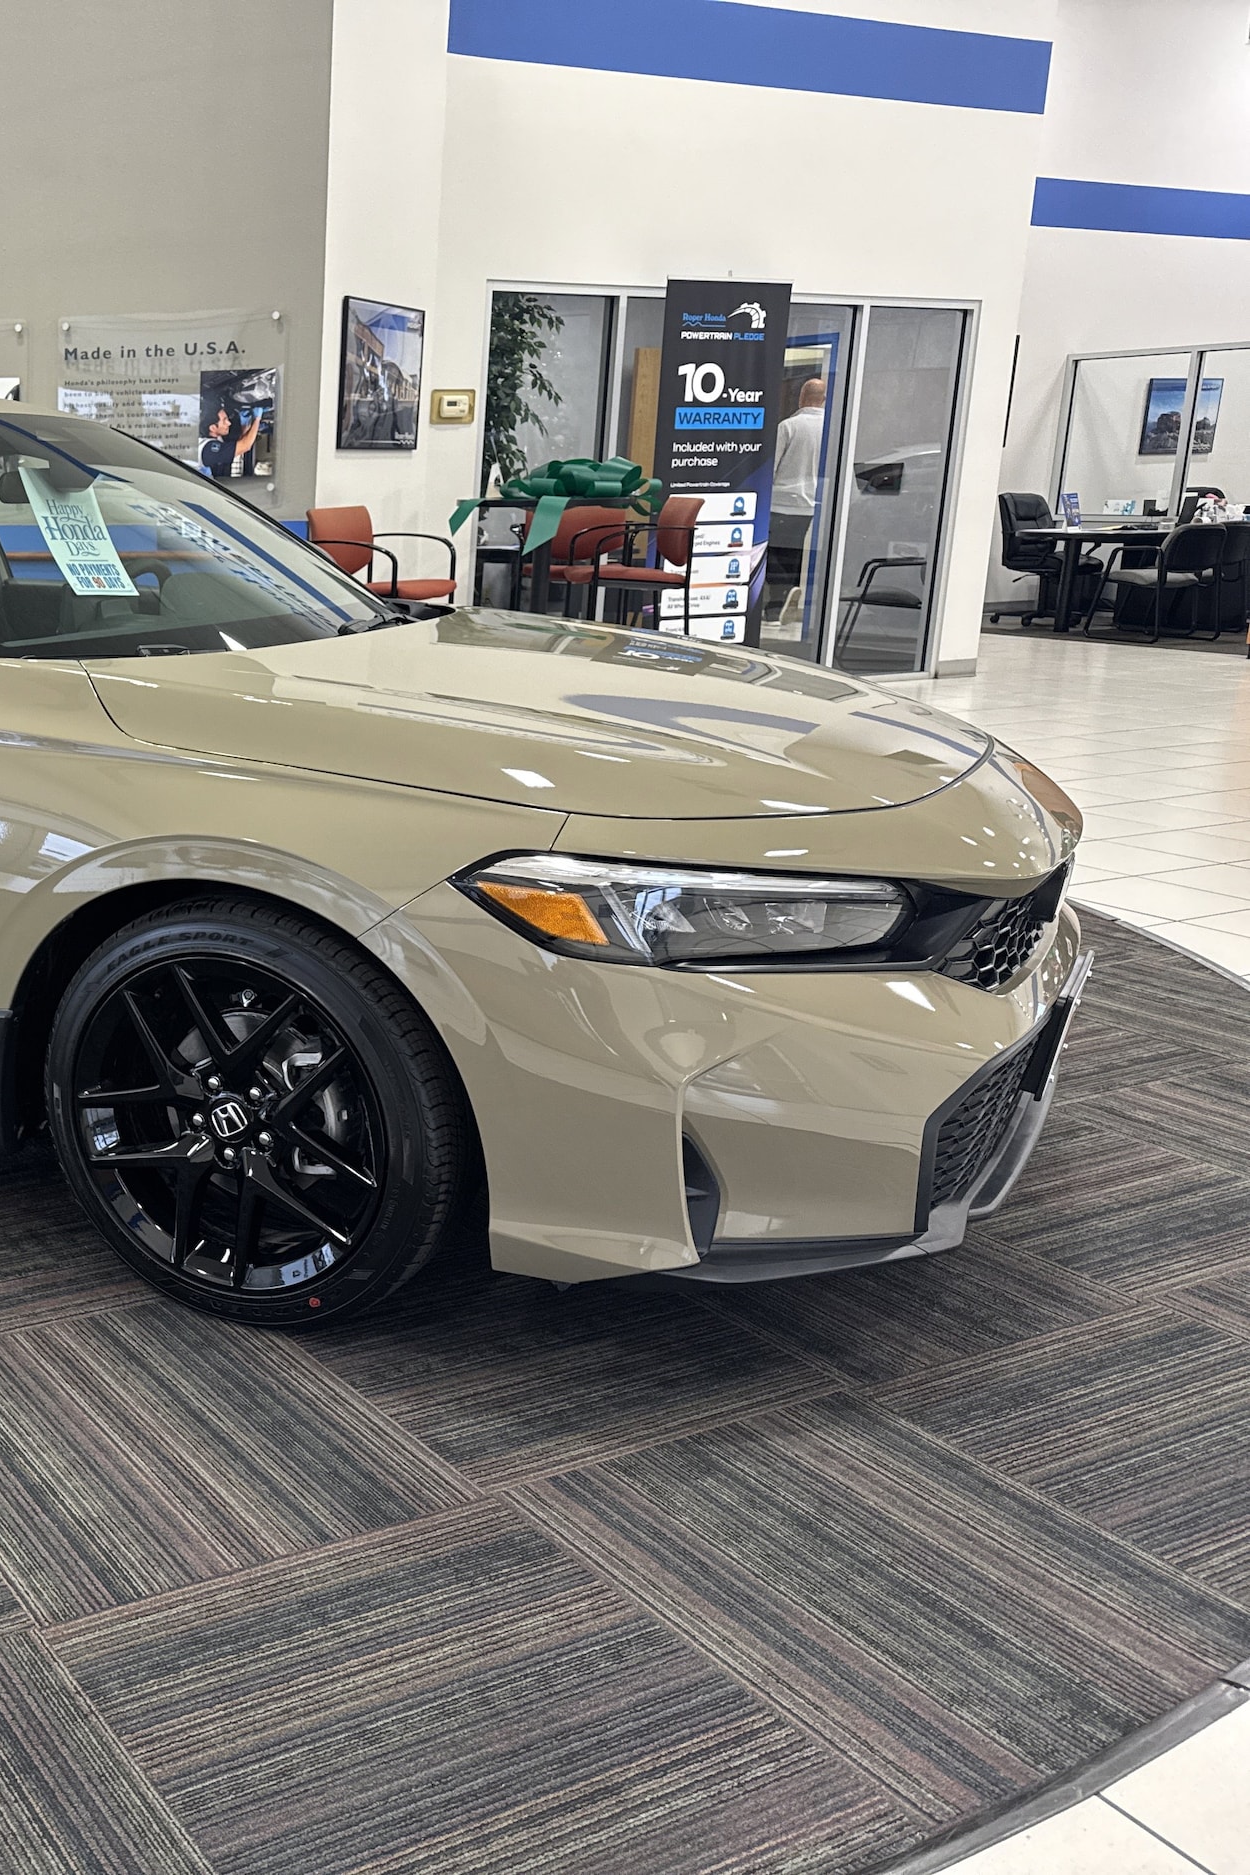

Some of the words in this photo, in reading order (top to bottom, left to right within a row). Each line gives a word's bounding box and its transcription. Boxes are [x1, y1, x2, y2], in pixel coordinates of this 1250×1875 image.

[682, 313, 702, 322] Roper
[705, 313, 726, 321] Honda
[681, 331, 732, 340] POWERTRAIN
[733, 332, 765, 341] PLEDGE
[64, 347, 112, 361] Made
[120, 345, 137, 359] in
[145, 344, 175, 358] the
[184, 341, 246, 356] U.S.A.
[678, 411, 761, 425] WARRANTY
[672, 441, 714, 453] Included
[716, 442, 738, 453] with
[739, 443, 762, 454] your
[671, 456, 718, 468] purchase
[46, 499, 84, 517] Happy
[41, 515, 108, 541] Honda
[64, 541, 99, 557] Days
[66, 563, 81, 576] NO
[79, 563, 121, 576] PAYMENTS
[76, 576, 94, 589] FOR
[92, 577, 107, 589] 90
[106, 577, 126, 589] DAYS
[105, 935, 171, 973] EAGLE
[178, 931, 254, 946] SPORT
